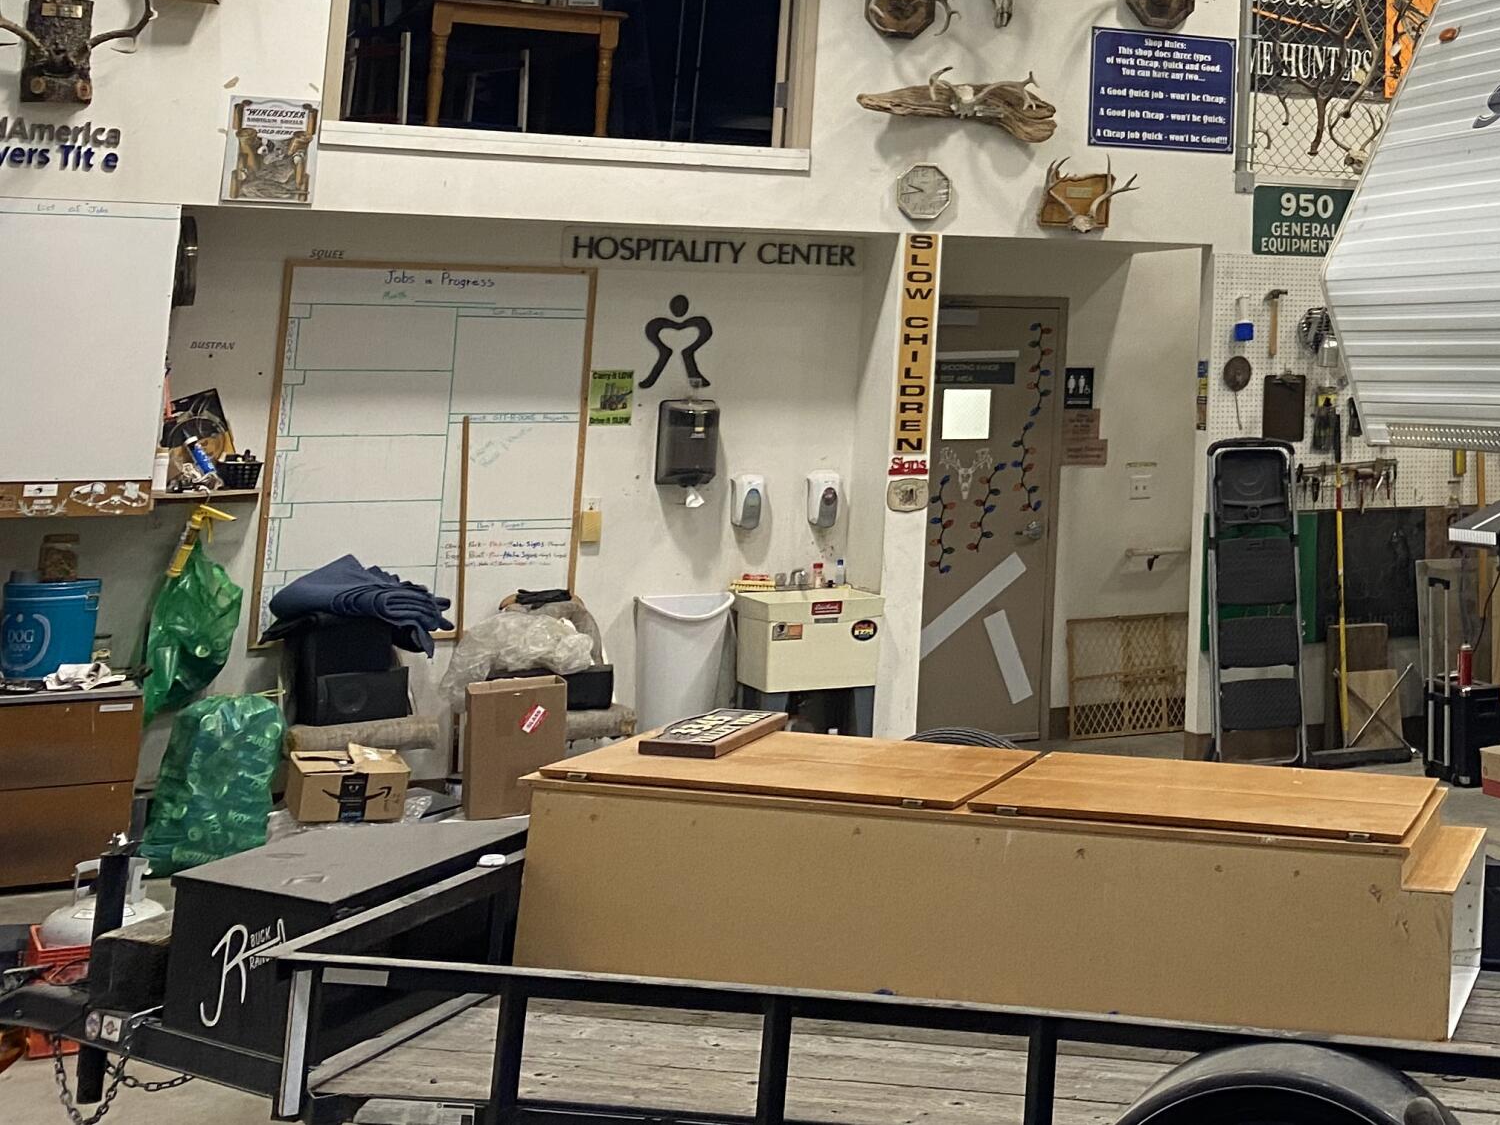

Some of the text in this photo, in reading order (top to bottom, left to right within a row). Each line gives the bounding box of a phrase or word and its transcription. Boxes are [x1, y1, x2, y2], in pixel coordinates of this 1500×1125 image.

[1144, 38, 1187, 49] Shop Rules:
[1118, 46, 1212, 62] This shop does three types
[1106, 56, 1222, 73] of work Cheap, Quick and Good.
[1121, 67, 1136, 76] You
[1137, 69, 1151, 77] can
[1152, 70, 1169, 79] have
[1170, 72, 1184, 81] any
[1100, 86, 1106, 95] A
[1107, 87, 1127, 96] Good
[1128, 89, 1150, 98] Quick
[1151, 90, 1164, 100] job
[1170, 92, 1190, 101] won't
[1191, 93, 1201, 101] be
[1099, 107, 1105, 116] A
[1106, 108, 1126, 117] Good
[1127, 109, 1140, 118] job
[1142, 110, 1165, 120] Cheap
[1170, 113, 1191, 122] won't
[1192, 114, 1202, 122] be
[1095, 128, 1101, 137] A
[1102, 129, 1126, 139] Cheap
[1127, 130, 1141, 140] job
[1141, 131, 1164, 141] Quick
[1169, 134, 1190, 143] won't
[1190, 135, 1200, 143] be
[1280, 192, 1334, 219] 950
[1270, 221, 1336, 238] GENERAL
[572, 235, 856, 267] HOSPITALITY CENTER
[904, 235, 933, 300] SLOW
[384, 269, 415, 285] Jobs
[441, 271, 496, 290] Progress
[190, 340, 235, 351] DUSTPAN
[896, 316, 929, 452] CHILDREN
[250, 925, 271, 948] BUCK
